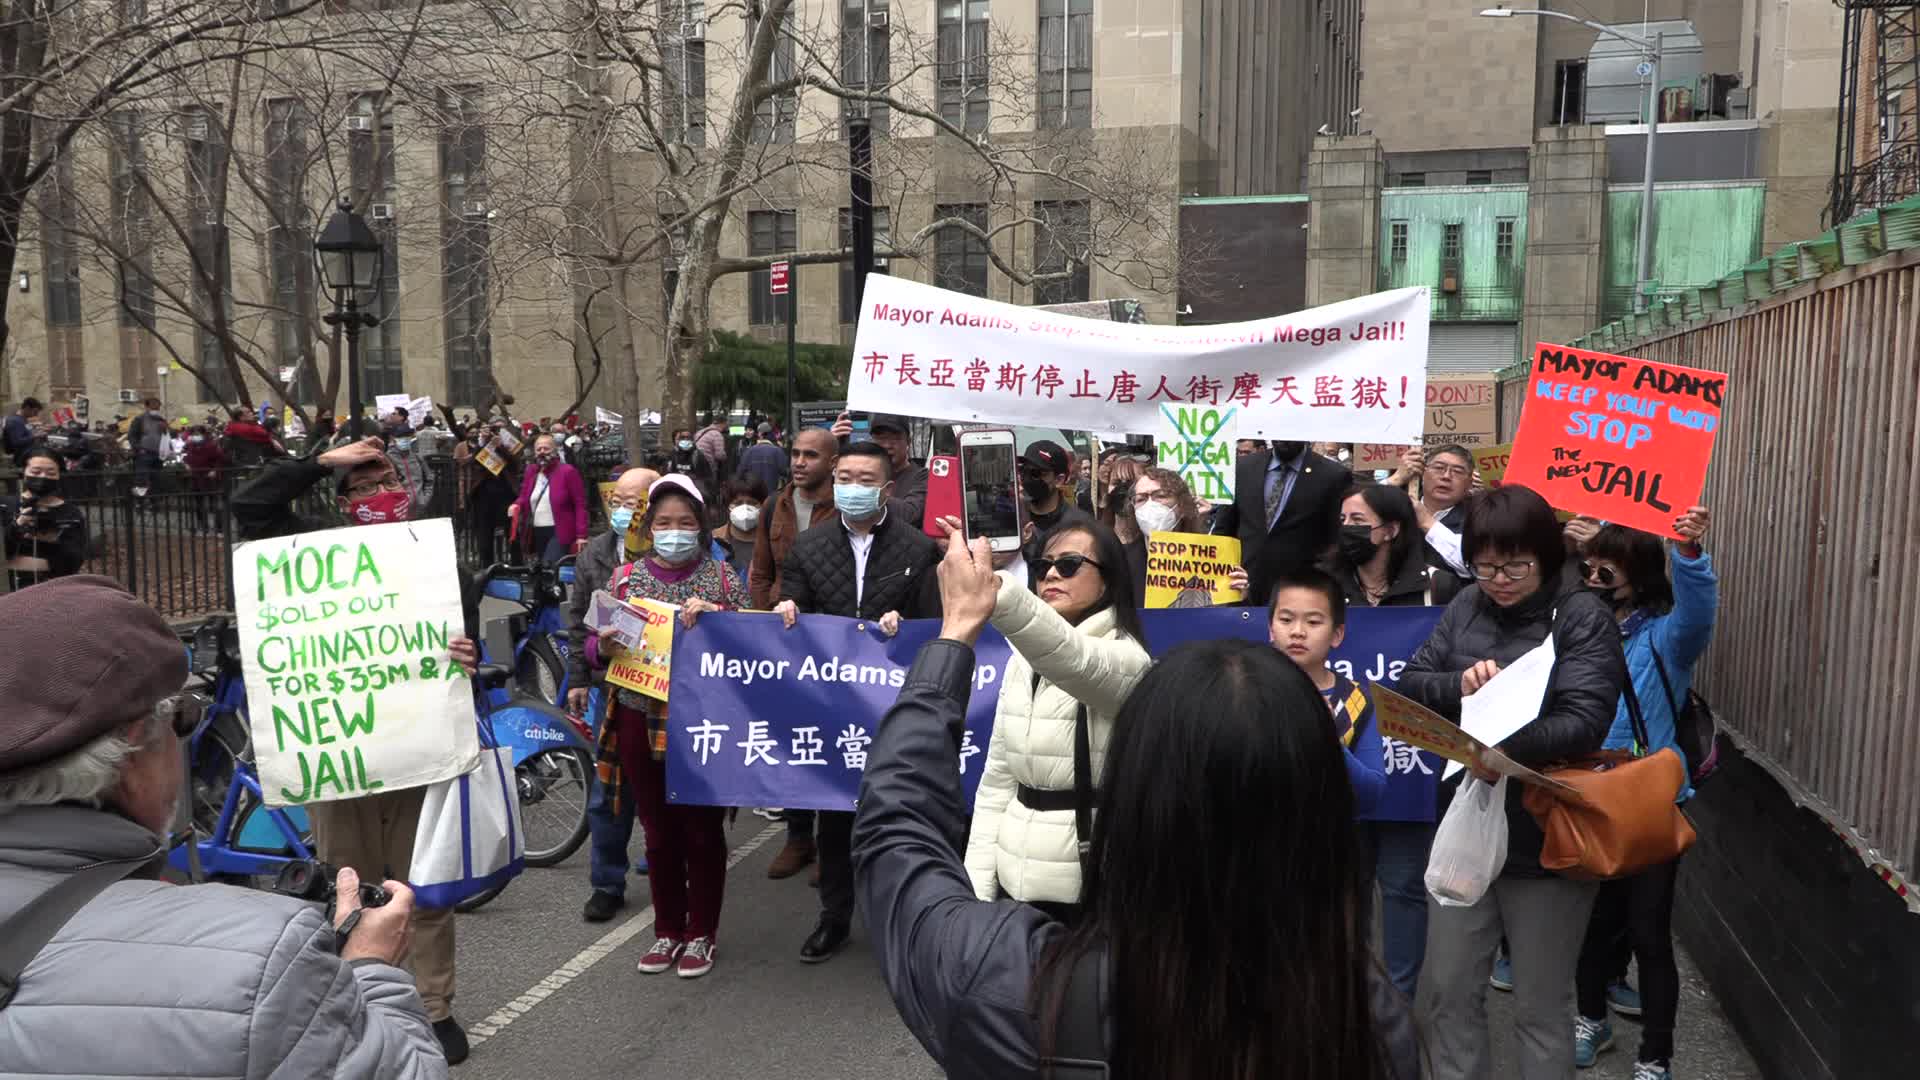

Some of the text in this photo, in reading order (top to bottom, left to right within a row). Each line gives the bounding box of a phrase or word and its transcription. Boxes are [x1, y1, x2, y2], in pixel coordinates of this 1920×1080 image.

[873, 303, 934, 326] Mayor
[1273, 323, 1341, 346] Mega
[1350, 320, 1405, 342] Jail!
[1536, 380, 1598, 404] KEEP
[1633, 365, 1724, 407] ADAMS
[1179, 408, 1220, 437] NO
[1433, 409, 1456, 430] US
[1566, 411, 1651, 449] STOP
[1158, 441, 1230, 466] MEGA
[1184, 471, 1233, 499] AIL
[1547, 461, 1671, 512] NEW JAIL
[1149, 542, 1216, 558] STOP THE
[256, 542, 382, 602] MOCA
[1148, 557, 1237, 576] CHINATOWN
[348, 593, 399, 615] OUT
[257, 621, 448, 674] CHINATOWN
[266, 673, 320, 696] FOR
[419, 656, 439, 680] &
[611, 663, 669, 693] INVEST IN
[700, 652, 790, 684] Mayor
[271, 692, 374, 752] NEW
[525, 726, 565, 742] citi bike
[281, 745, 384, 803] JAIL
